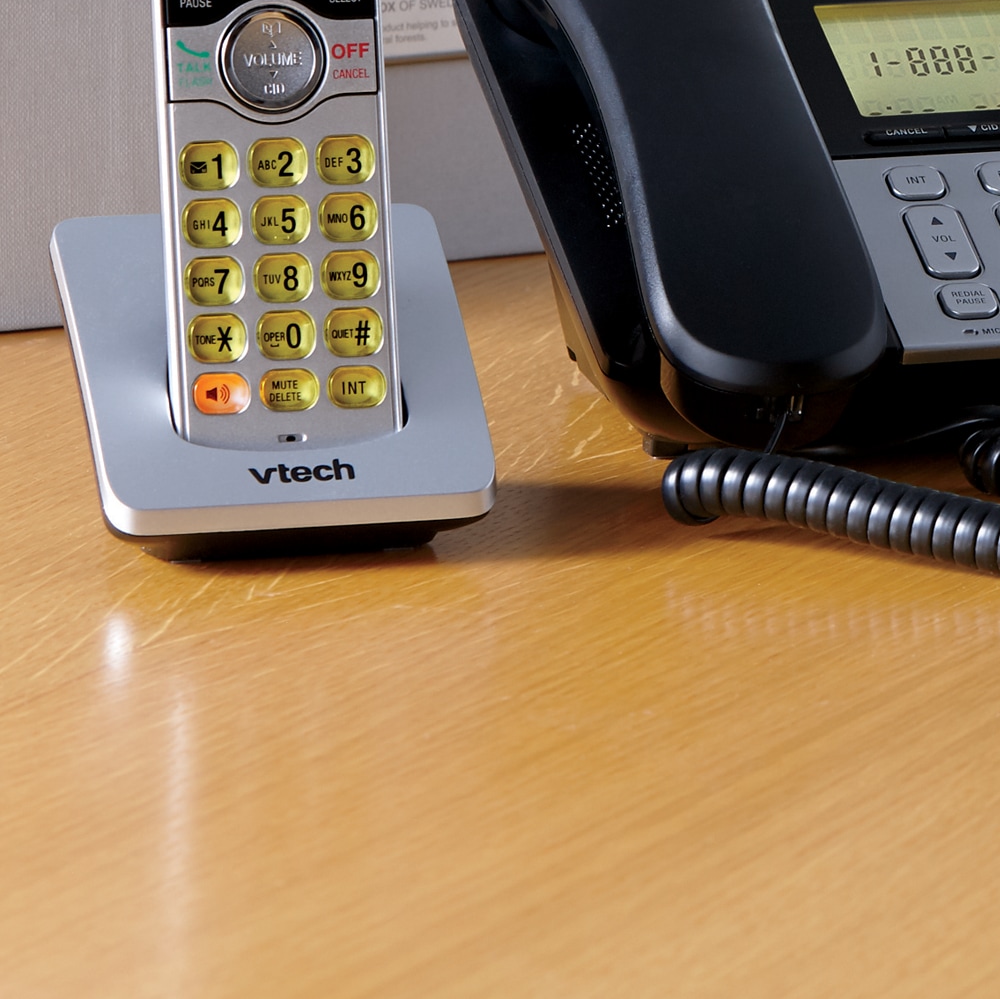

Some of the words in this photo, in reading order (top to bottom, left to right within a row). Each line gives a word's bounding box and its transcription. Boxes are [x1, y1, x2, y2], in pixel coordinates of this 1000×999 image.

[399, 0, 416, 11] OF
[331, 42, 370, 59] OFF
[178, 62, 211, 73] TALK
[243, 51, 302, 68] VOLUME
[333, 68, 370, 79] CANCEL
[264, 83, 285, 95] CID
[886, 127, 928, 136] CANCEL
[981, 123, 999, 132] CID
[212, 153, 223, 179] 1
[257, 159, 277, 171] ABC
[278, 151, 294, 177] 2
[325, 157, 343, 168] DEF
[346, 148, 361, 174] 3
[906, 175, 926, 184] INT
[193, 219, 210, 230] GHI
[212, 211, 228, 237] 4
[261, 216, 279, 227] JKL
[281, 208, 297, 233] 5
[327, 213, 348, 224] MNO
[350, 205, 366, 230] 6
[932, 235, 956, 243] VOL
[192, 276, 215, 287] PQRS
[214, 269, 230, 294] 7
[263, 273, 281, 284] TUV
[283, 265, 299, 291] 8
[329, 271, 351, 281] WXYZ
[352, 262, 368, 287] 9
[195, 334, 216, 345] TONE
[264, 331, 285, 342] OPER
[286, 323, 301, 348] 0
[331, 328, 354, 339] QUIET
[354, 320, 371, 346] #
[982, 327, 1000, 335] MIC
[272, 380, 298, 390] MUTE
[342, 381, 366, 395] INT
[269, 392, 302, 402] DELETE
[248, 458, 355, 484] vtech
